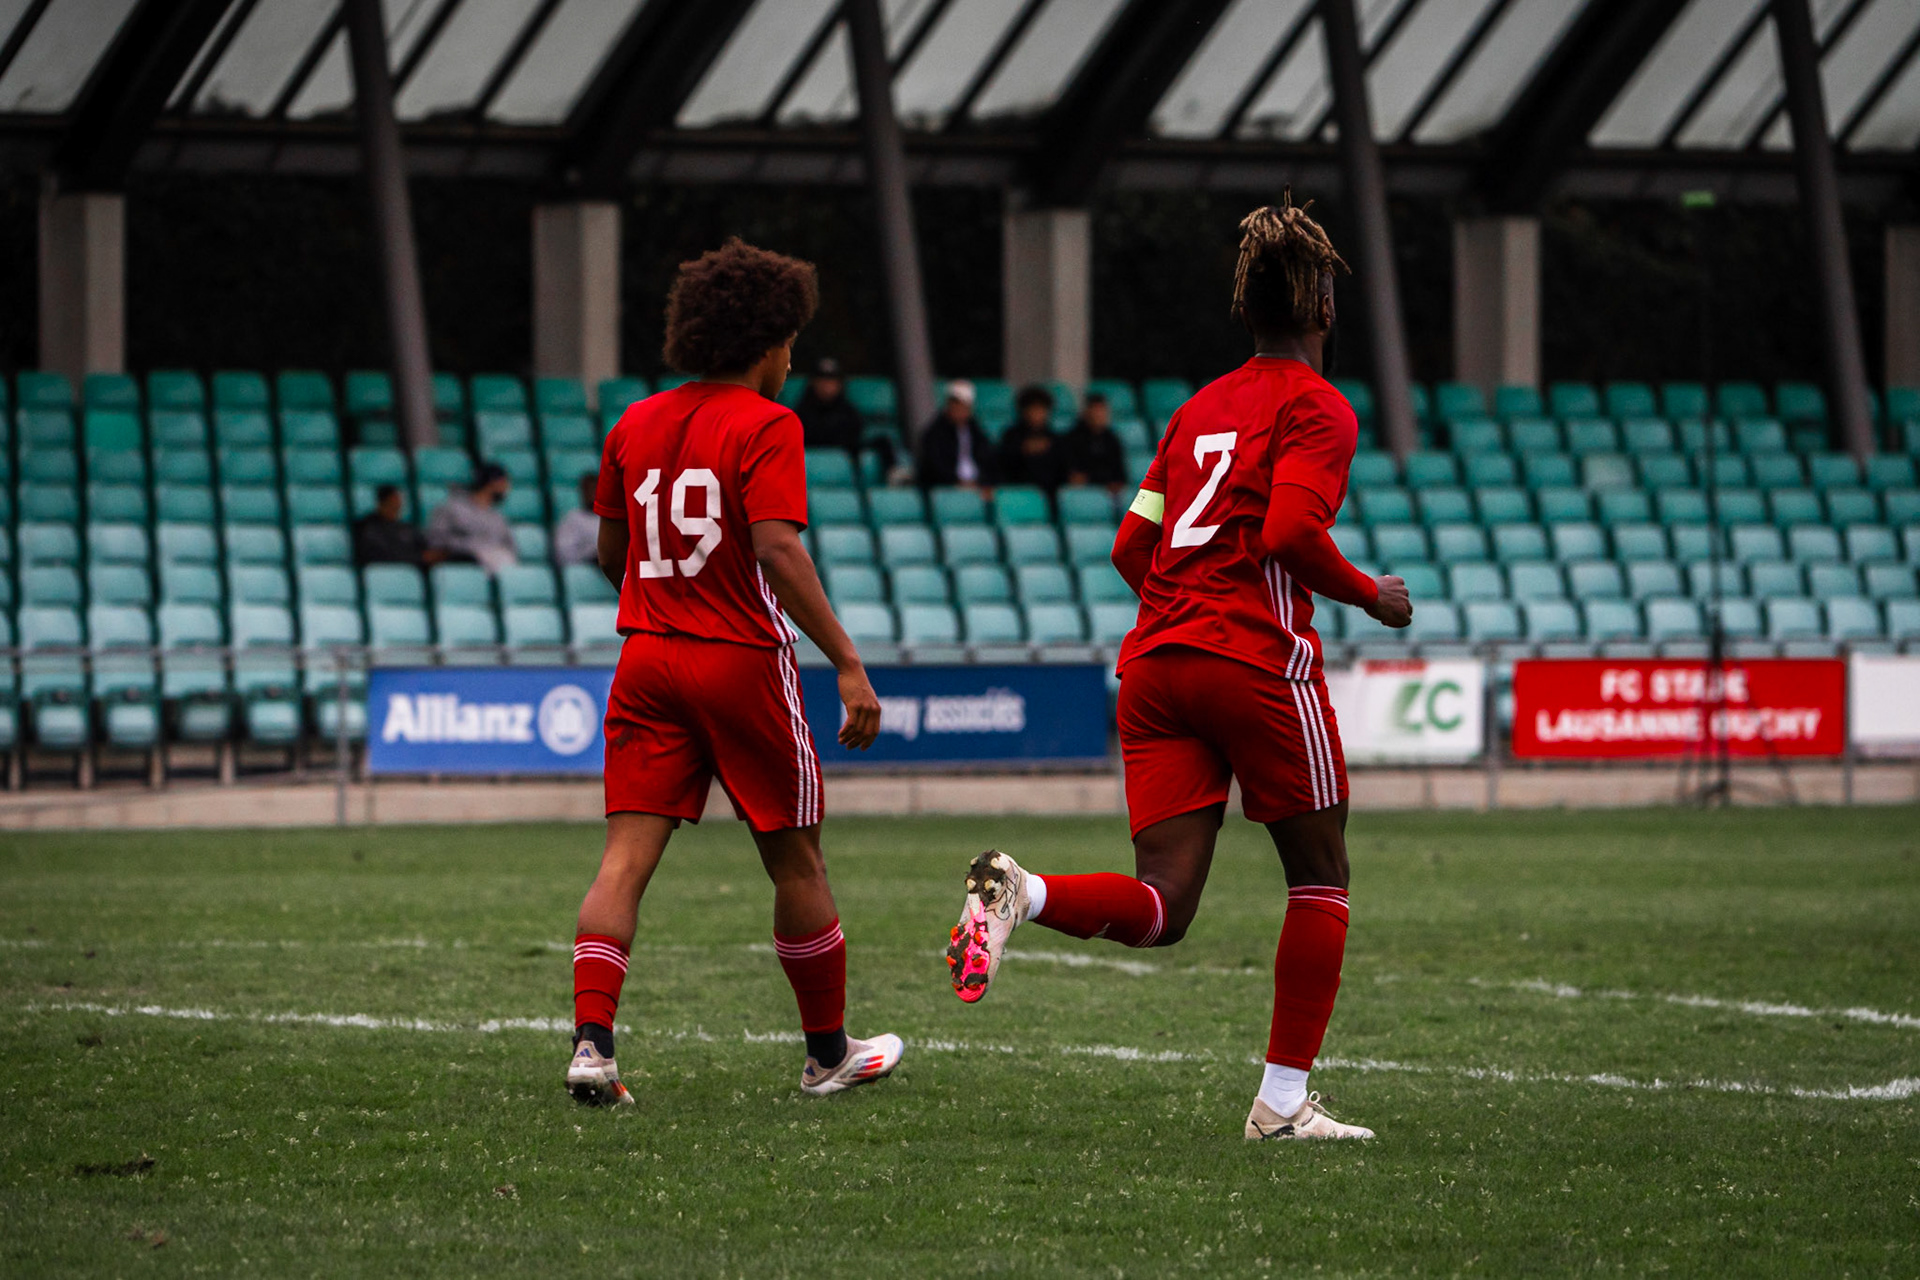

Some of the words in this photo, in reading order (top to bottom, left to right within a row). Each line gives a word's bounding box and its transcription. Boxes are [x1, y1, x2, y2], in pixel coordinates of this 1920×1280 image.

[1170, 431, 1237, 548] 2
[633, 468, 722, 578] 19
[1601, 668, 1643, 702] FC
[382, 693, 534, 742] Allianz
[1536, 708, 1705, 742] LAUSANNE
